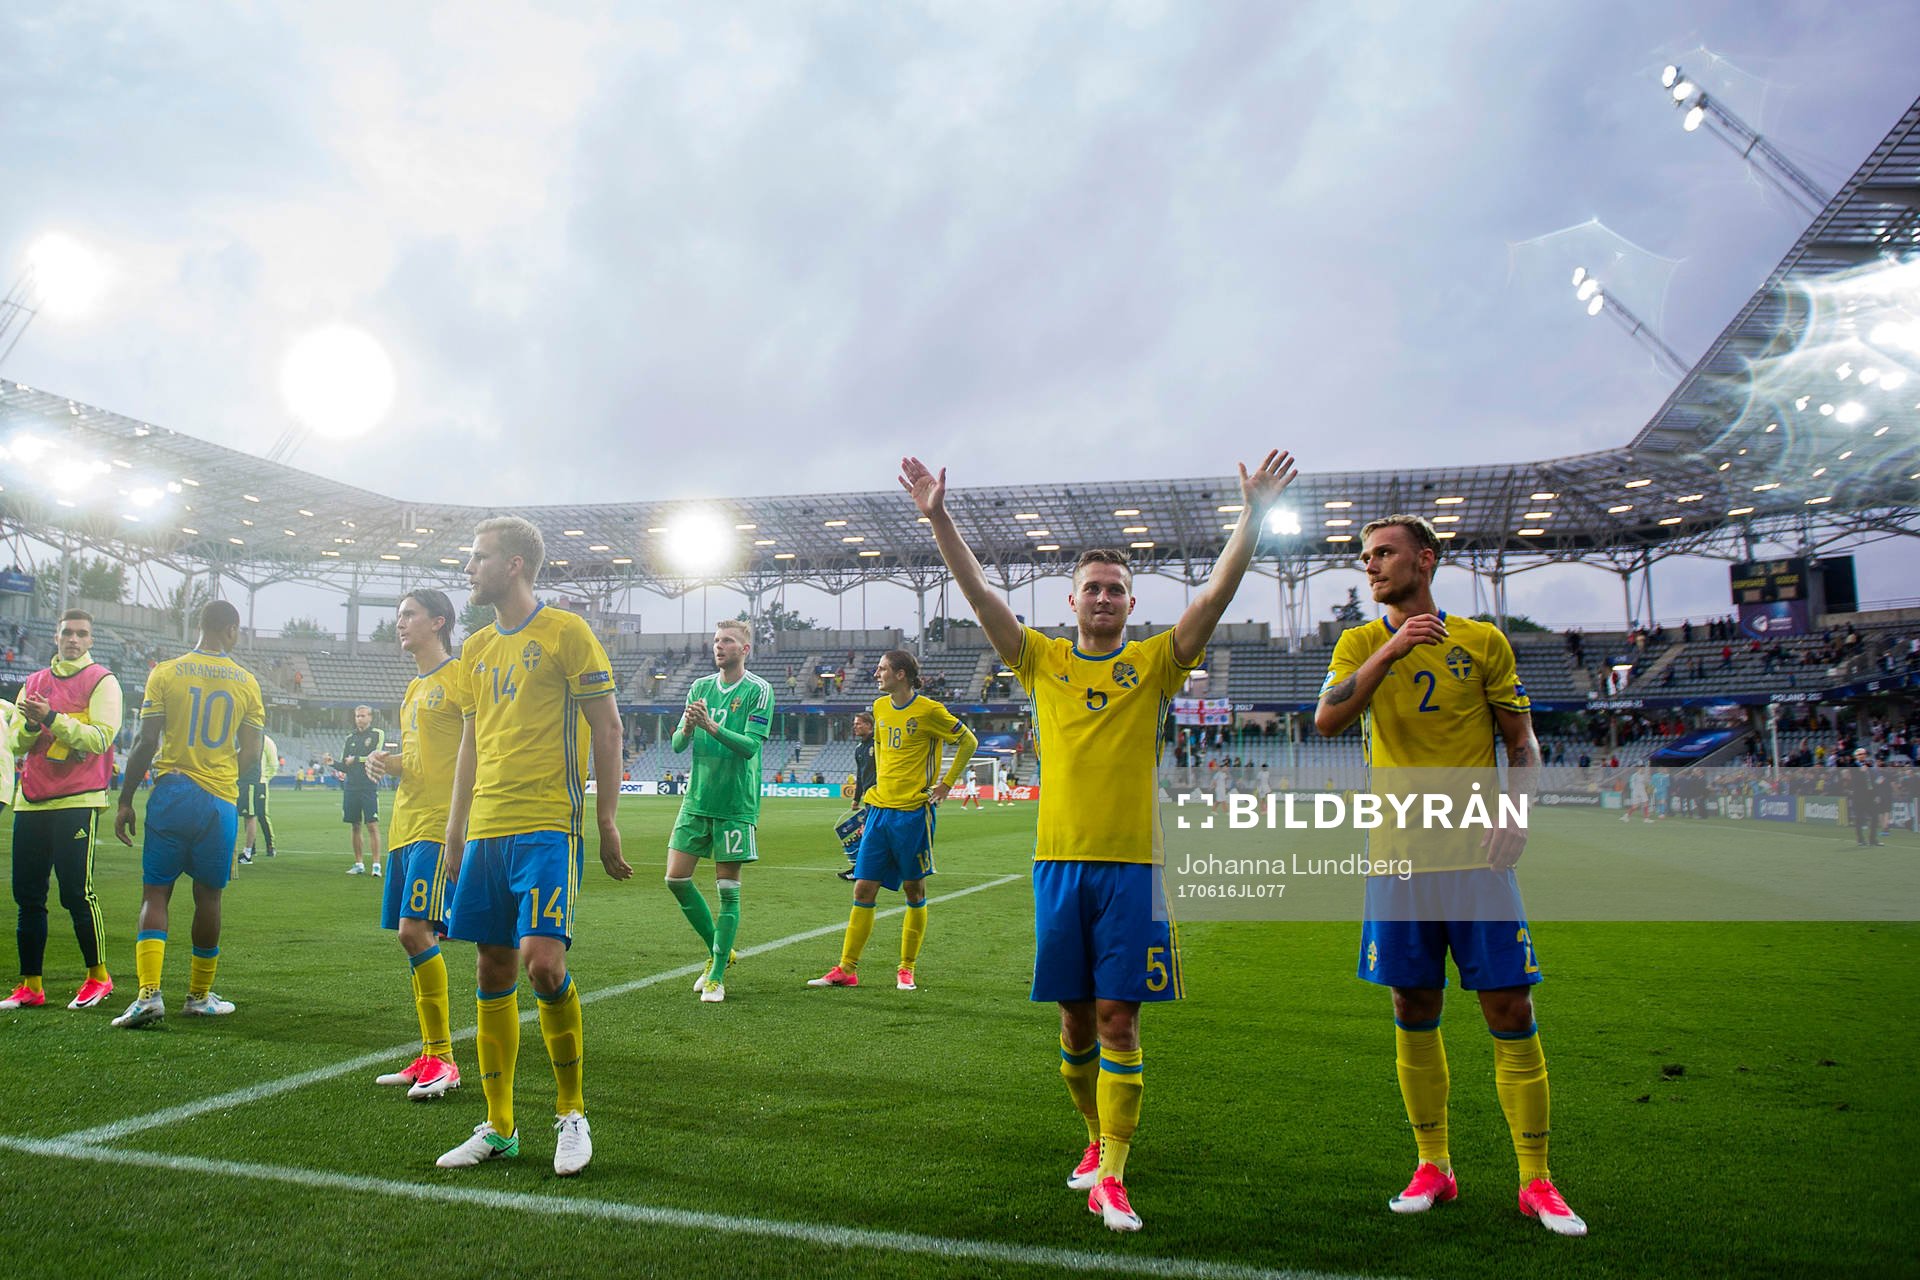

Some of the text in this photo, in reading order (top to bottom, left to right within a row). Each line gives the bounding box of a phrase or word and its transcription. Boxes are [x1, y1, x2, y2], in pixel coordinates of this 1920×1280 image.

[176, 662, 248, 683] STRANDBERG
[492, 664, 517, 704] 14
[1086, 687, 1107, 711] 5
[1414, 670, 1440, 713] 2
[187, 686, 234, 749] 10
[888, 727, 901, 749] 18
[760, 783, 829, 798] Hisense
[724, 829, 744, 854] 12
[410, 879, 428, 912] 8
[530, 886, 564, 929] 14
[1146, 947, 1168, 991] 5
[1517, 928, 1539, 974] 2
